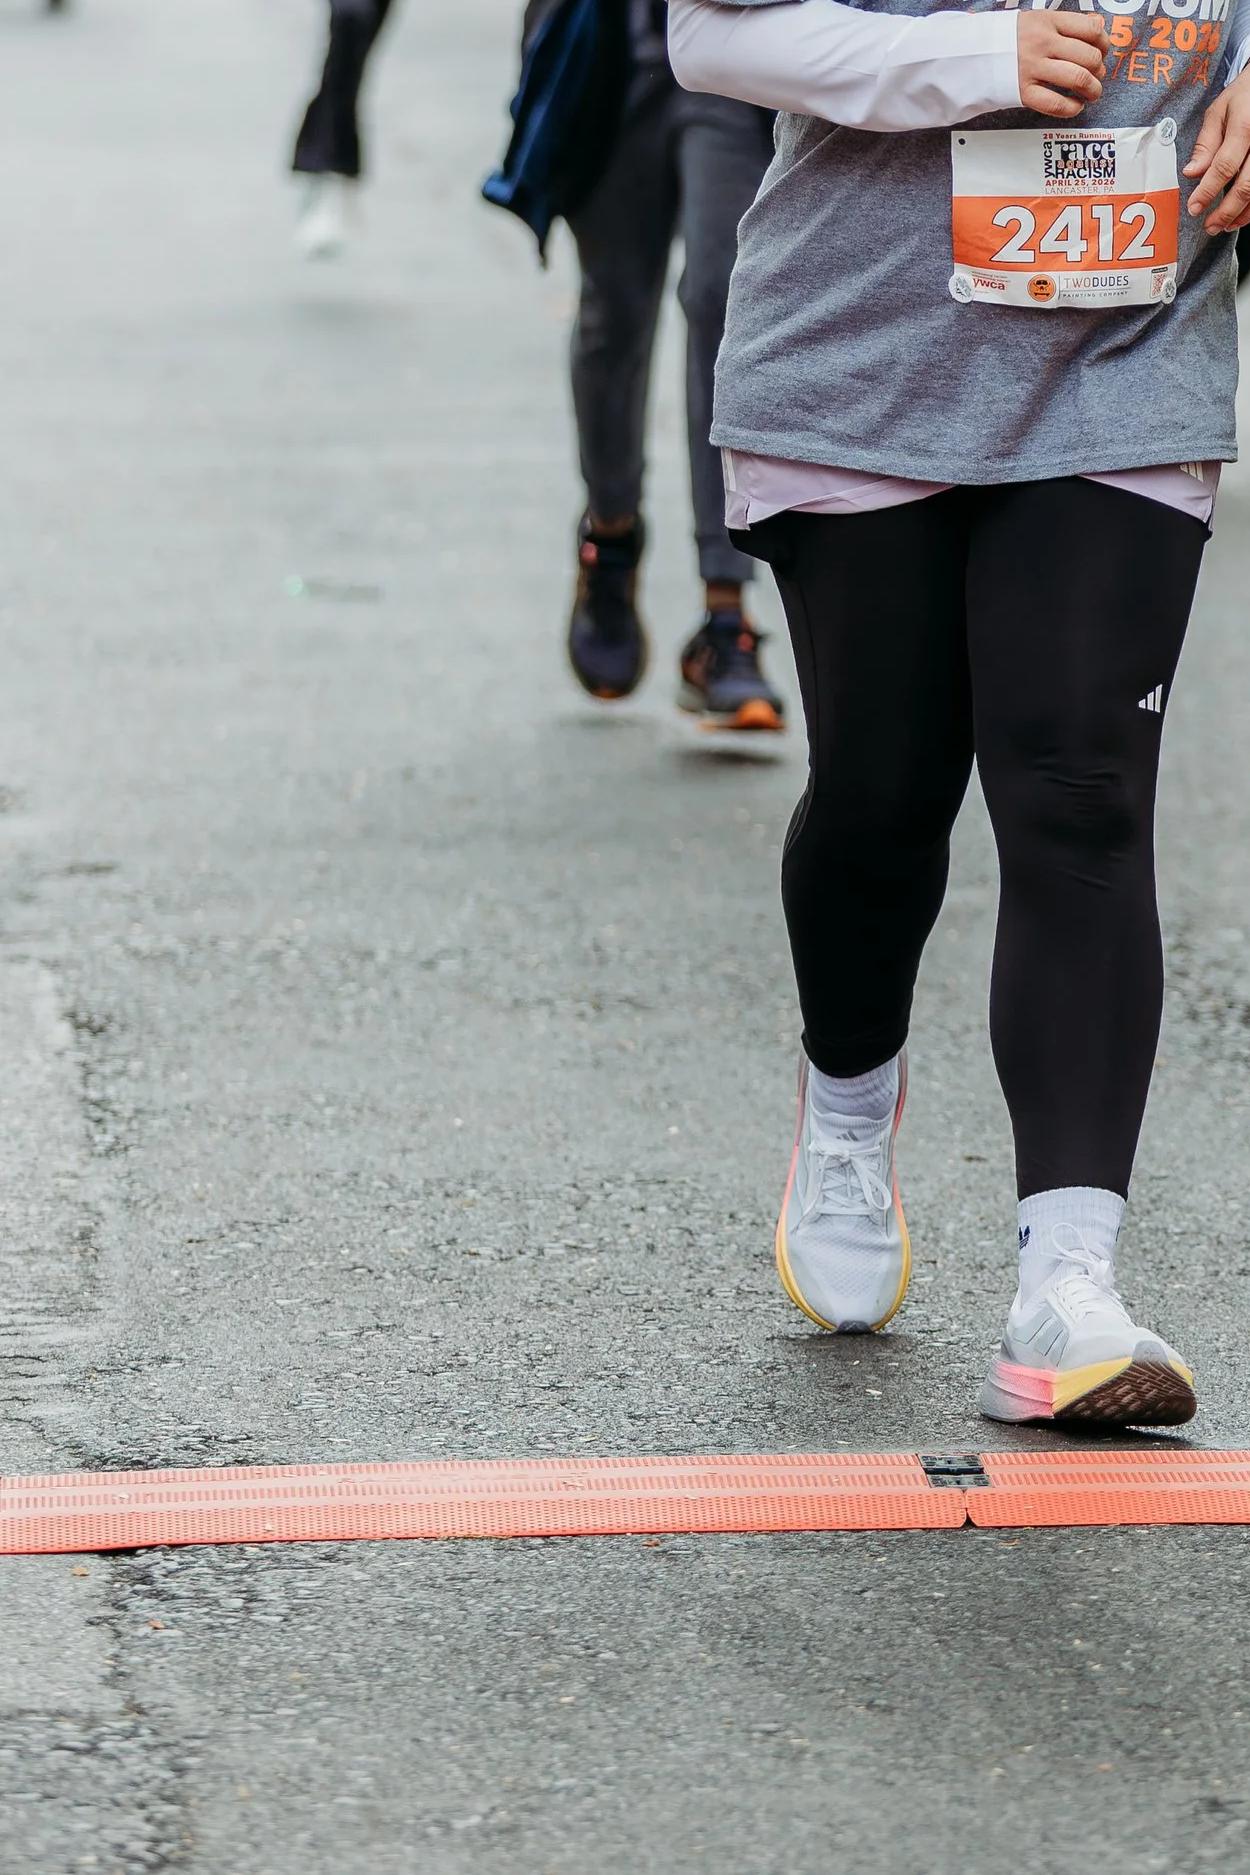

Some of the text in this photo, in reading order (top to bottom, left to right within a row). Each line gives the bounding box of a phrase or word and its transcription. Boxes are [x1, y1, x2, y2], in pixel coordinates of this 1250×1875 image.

[1079, 132, 1115, 141] Running!
[1053, 142, 1116, 160] race
[1043, 141, 1055, 179] ywca
[1055, 166, 1115, 179] RACISM
[1045, 178, 1115, 187] APRIL 25, 2026
[1104, 186, 1115, 194] PA
[990, 201, 1156, 263] 2412
[973, 277, 1006, 291] ywca
